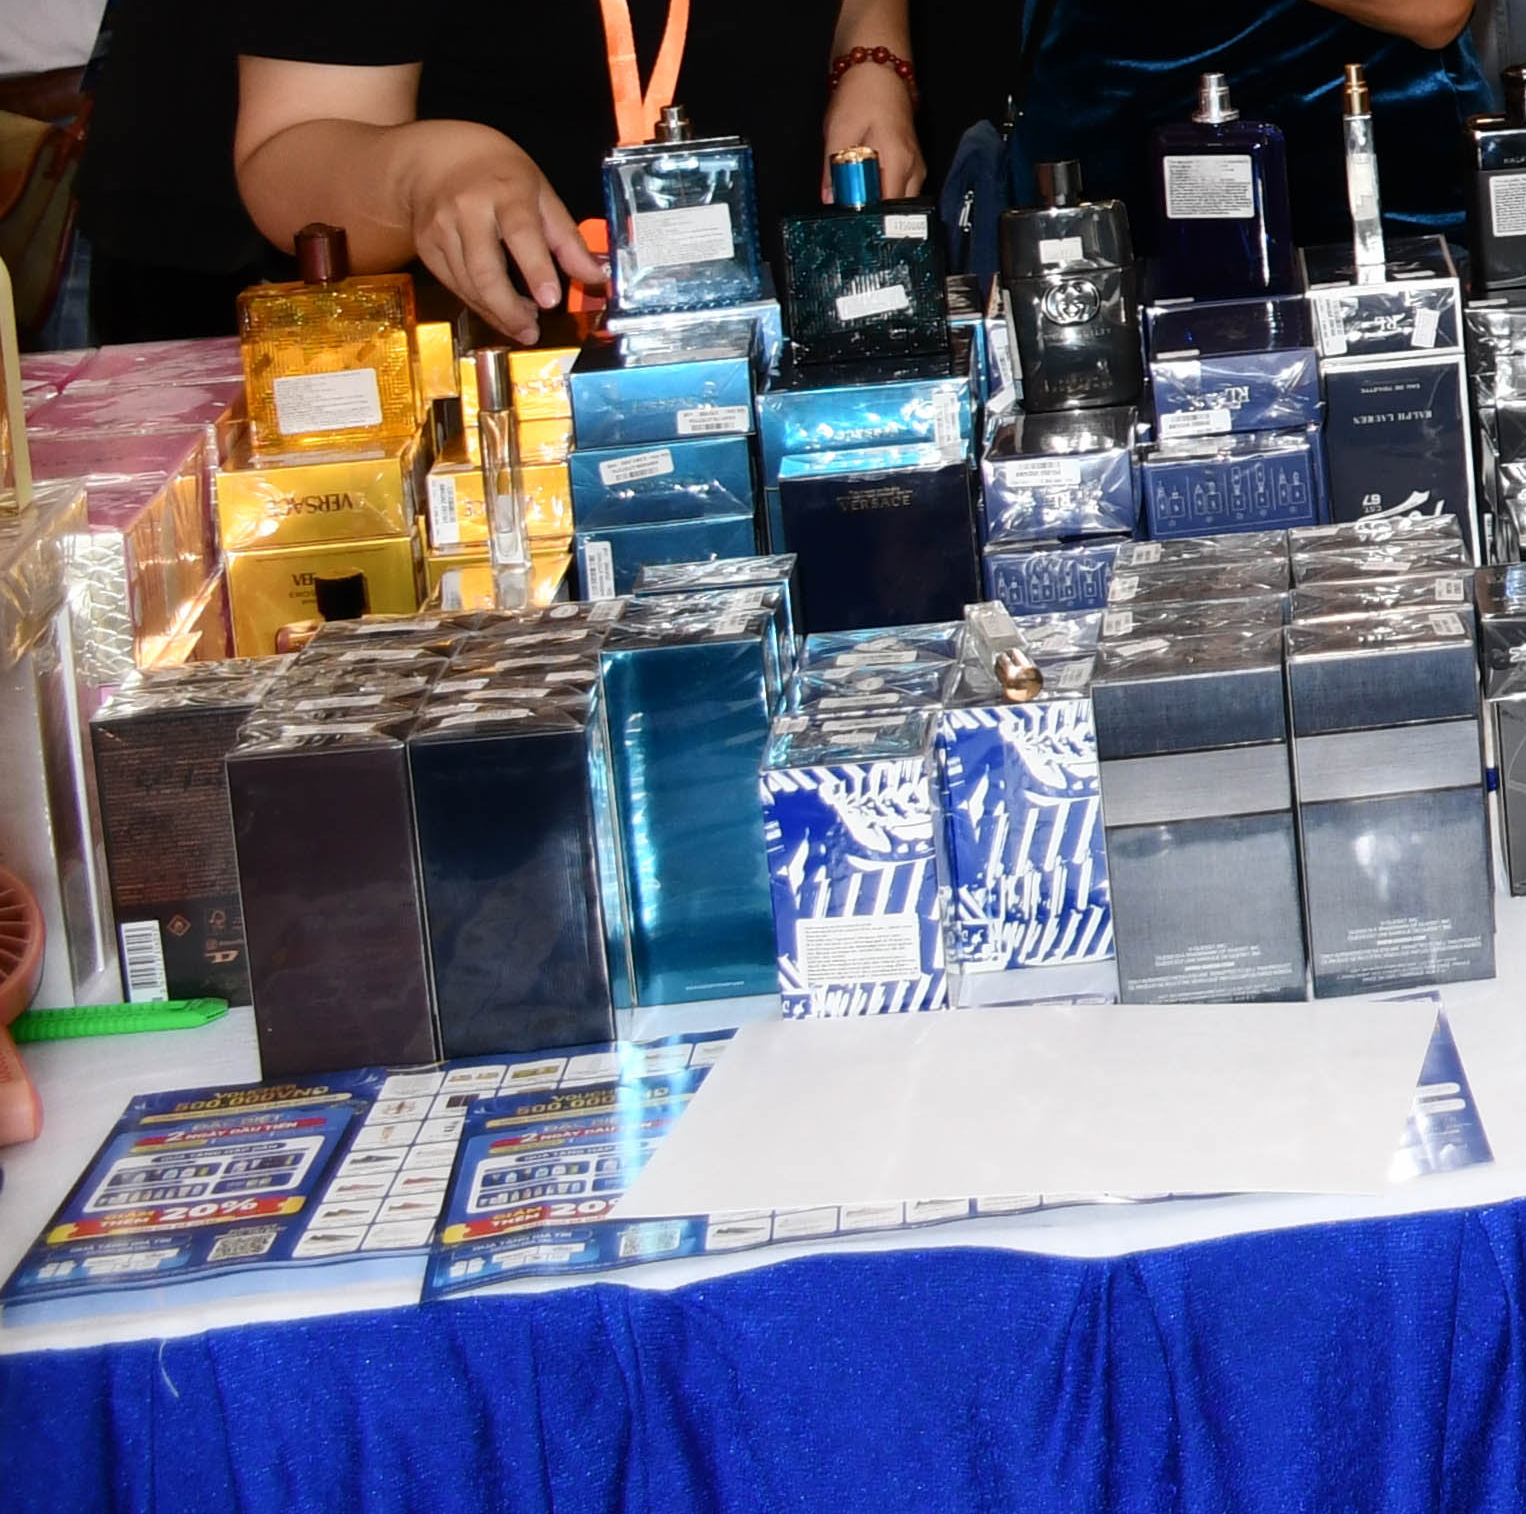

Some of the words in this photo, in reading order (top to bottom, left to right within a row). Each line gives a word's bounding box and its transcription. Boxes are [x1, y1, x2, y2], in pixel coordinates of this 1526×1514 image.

[1353, 412, 1394, 425] LAUREN
[1398, 409, 1433, 421] RALPH
[166, 1131, 185, 1143] 2
[520, 1132, 539, 1144] 2
[160, 1197, 259, 1222] 20%
